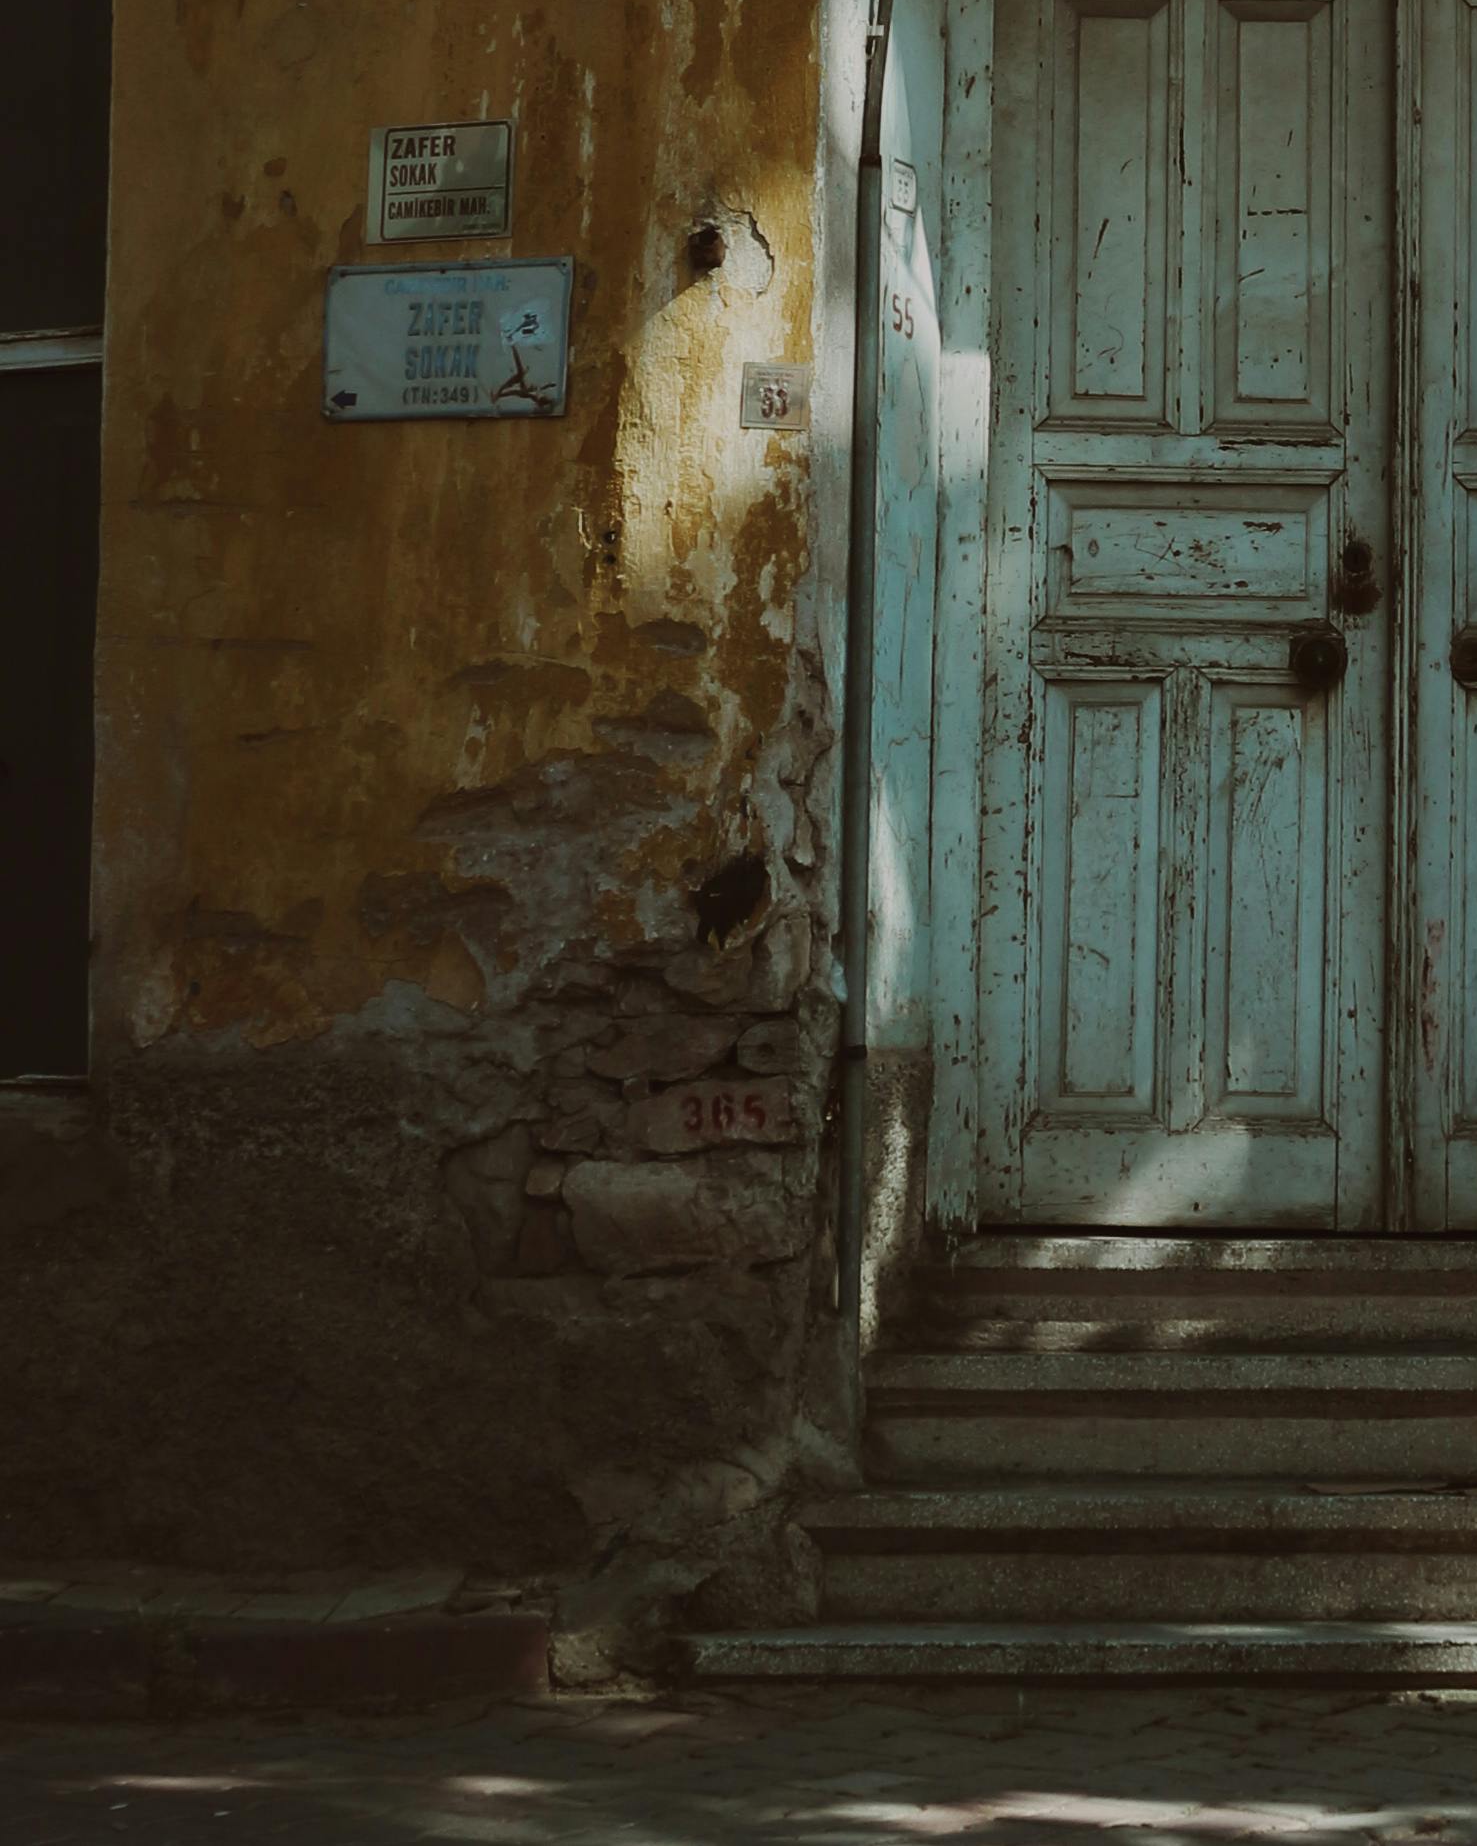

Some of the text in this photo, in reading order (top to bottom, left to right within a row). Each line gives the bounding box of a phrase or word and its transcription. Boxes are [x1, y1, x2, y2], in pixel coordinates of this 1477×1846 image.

[391, 135, 457, 160] ZAFER
[389, 162, 437, 187] SOKAK
[460, 196, 491, 215] MAH.
[406, 300, 484, 337] ZAFER
[404, 344, 480, 381] SOKAK
[682, 1091, 766, 1132] 365
